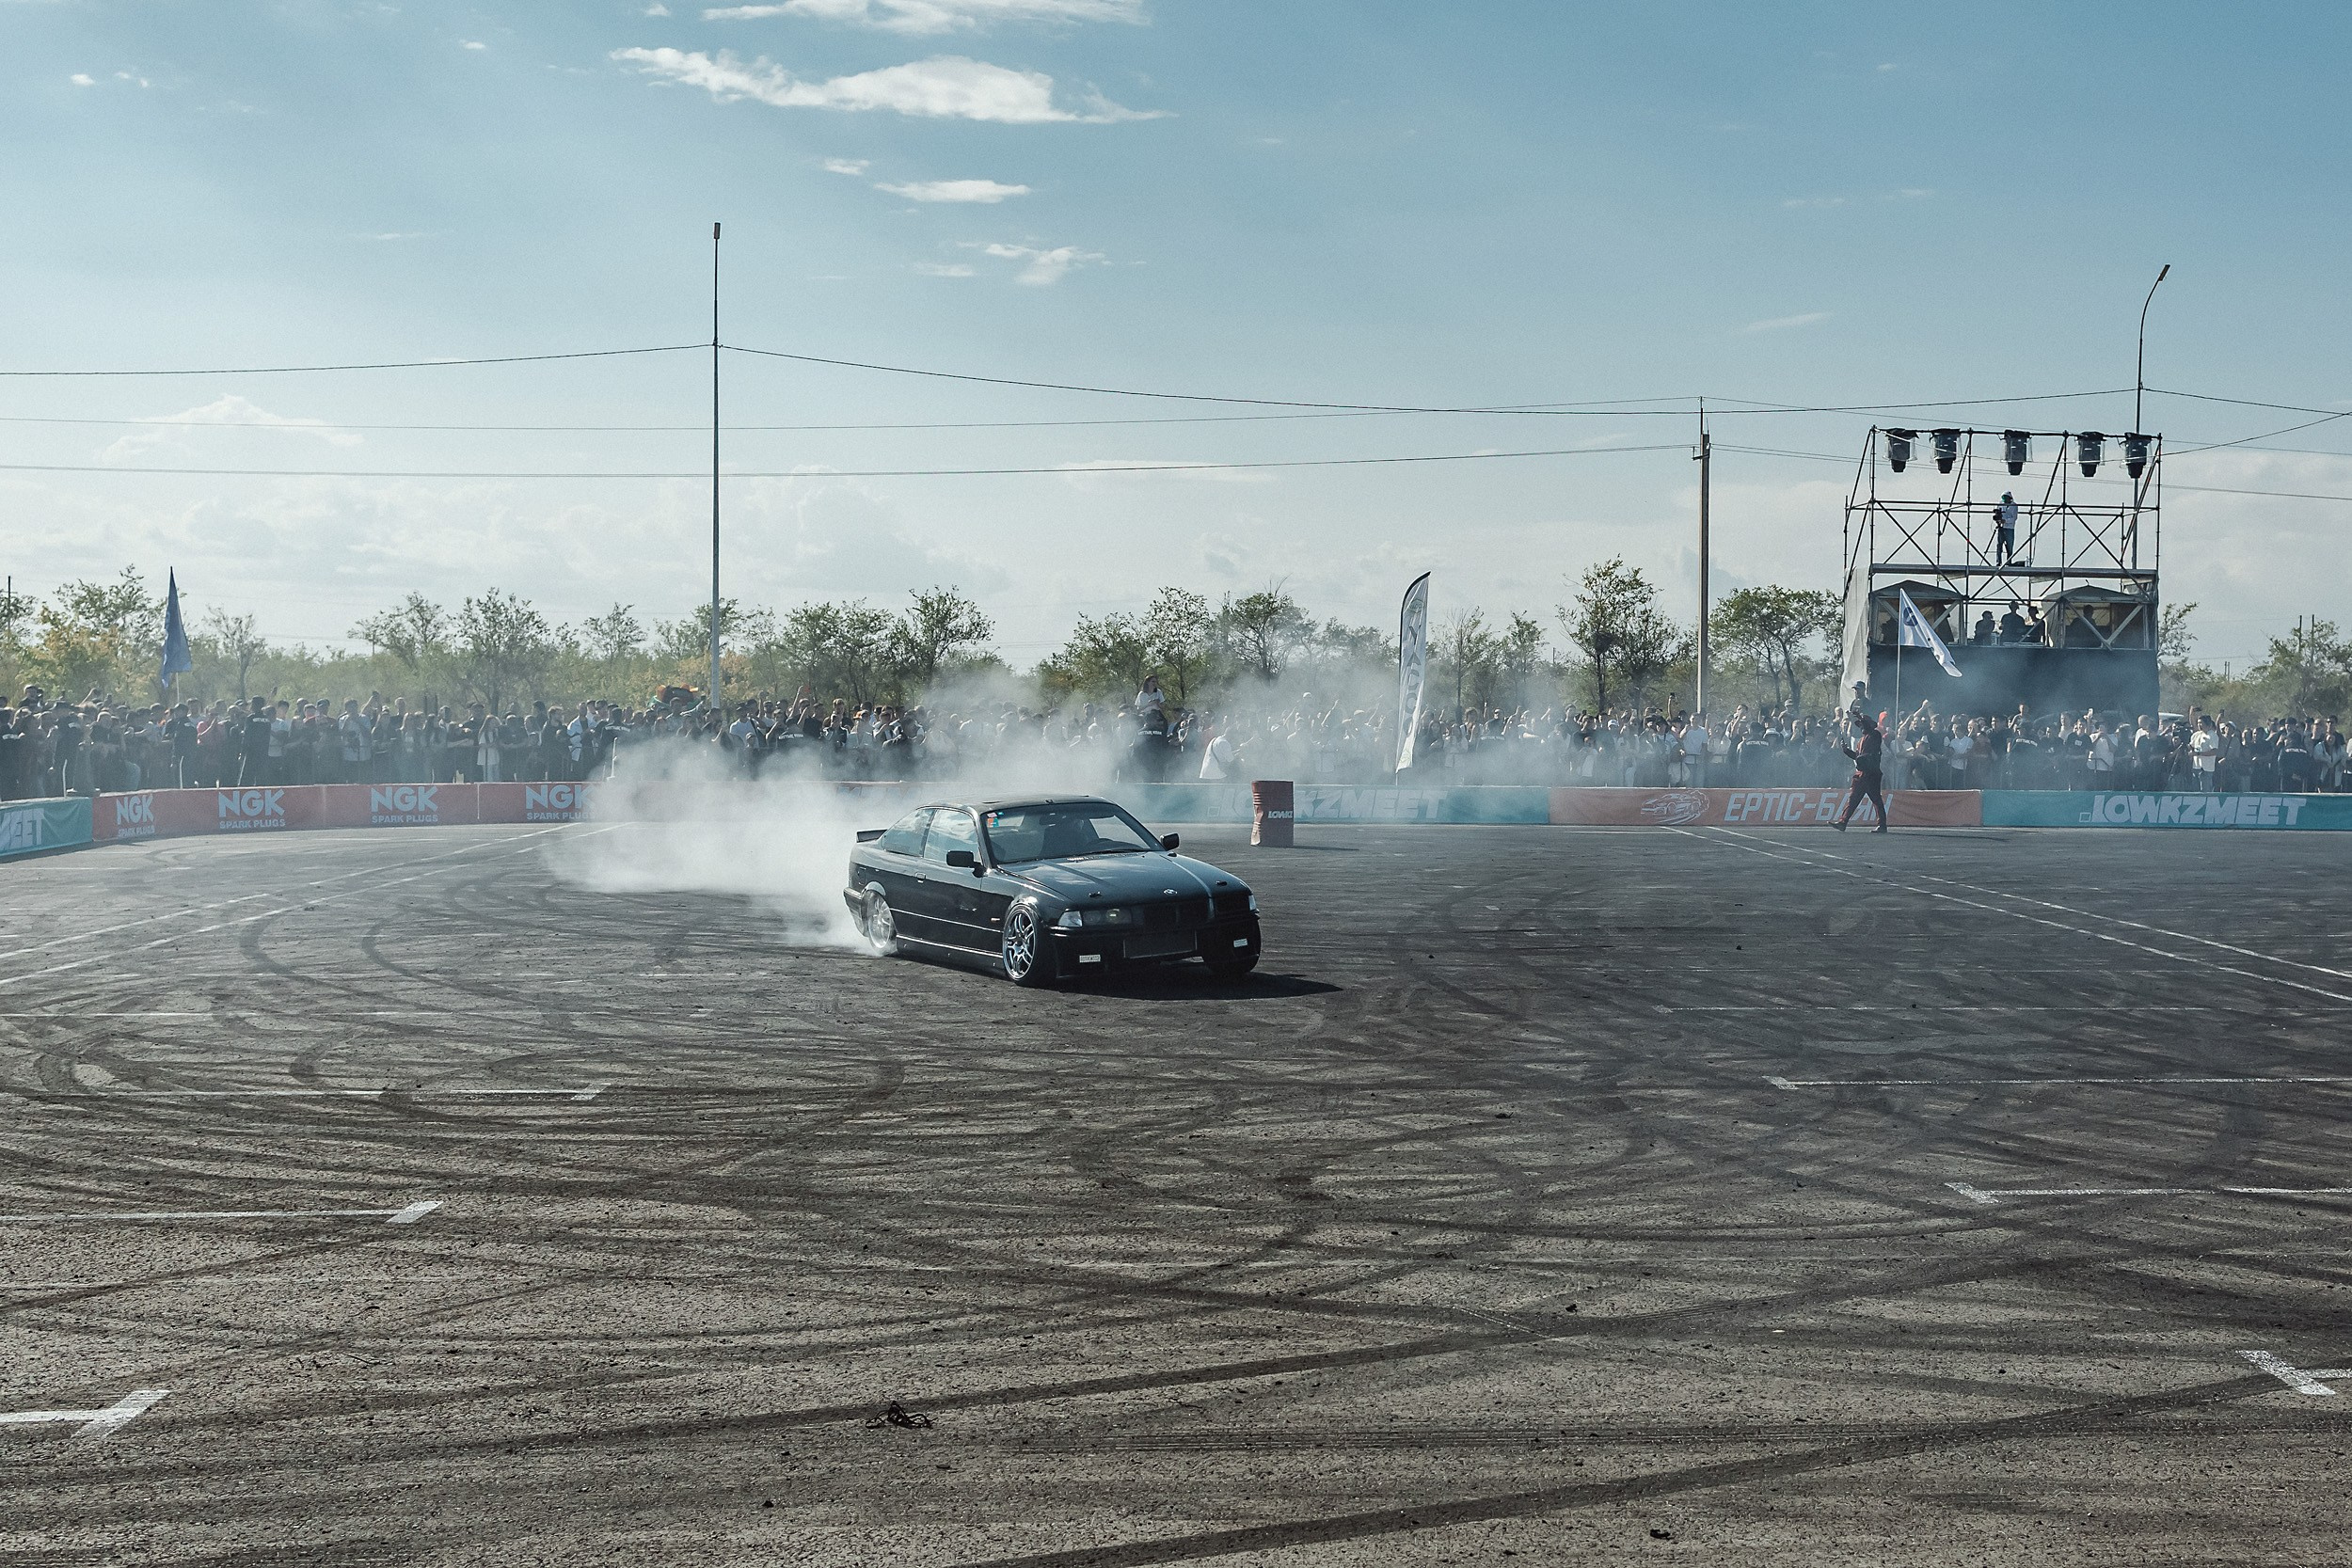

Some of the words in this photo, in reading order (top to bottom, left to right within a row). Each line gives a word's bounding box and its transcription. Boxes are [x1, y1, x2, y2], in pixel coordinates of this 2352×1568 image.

[117, 794, 154, 825] NGK
[218, 789, 286, 818] NGK
[371, 785, 438, 813] NGK
[525, 784, 595, 810] NGK
[1223, 787, 1448, 818] LOKZMEET
[219, 819, 252, 830] SPARK
[253, 818, 286, 828] PLUGS
[372, 815, 404, 824] SPARK
[405, 815, 438, 823] PLUGS
[527, 812, 560, 820] SPARK
